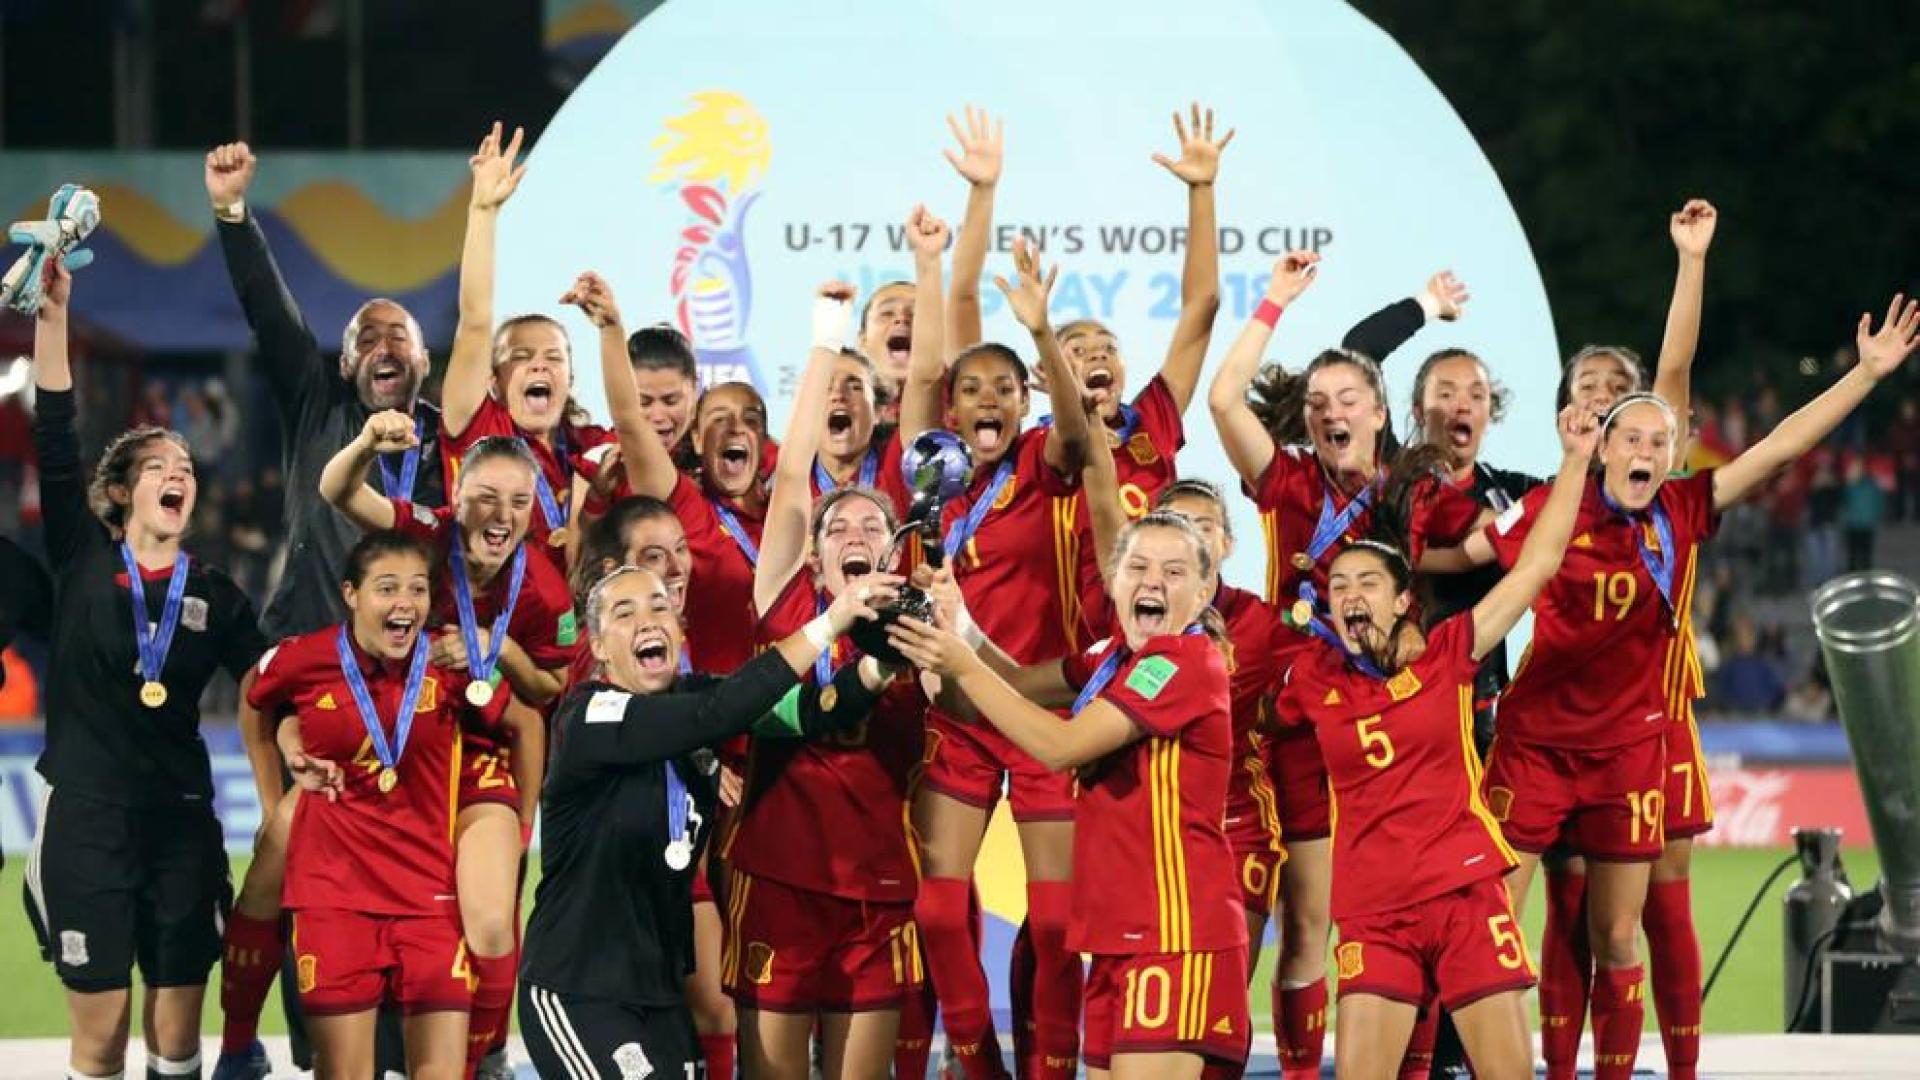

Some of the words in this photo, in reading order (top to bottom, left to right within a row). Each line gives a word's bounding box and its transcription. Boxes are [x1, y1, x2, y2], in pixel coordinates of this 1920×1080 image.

[784, 223, 870, 252] U-17
[888, 224, 1084, 253] WEN'S
[1100, 225, 1244, 254] WORD
[1257, 226, 1334, 255] CUP
[1148, 270, 1274, 322] 218
[1593, 571, 1637, 621] 19
[1356, 713, 1395, 769] 5
[1626, 788, 1664, 845] 19
[1671, 761, 1693, 818] 7
[451, 936, 479, 993] 4
[1488, 914, 1521, 969] 5
[1123, 965, 1170, 1030] 10
